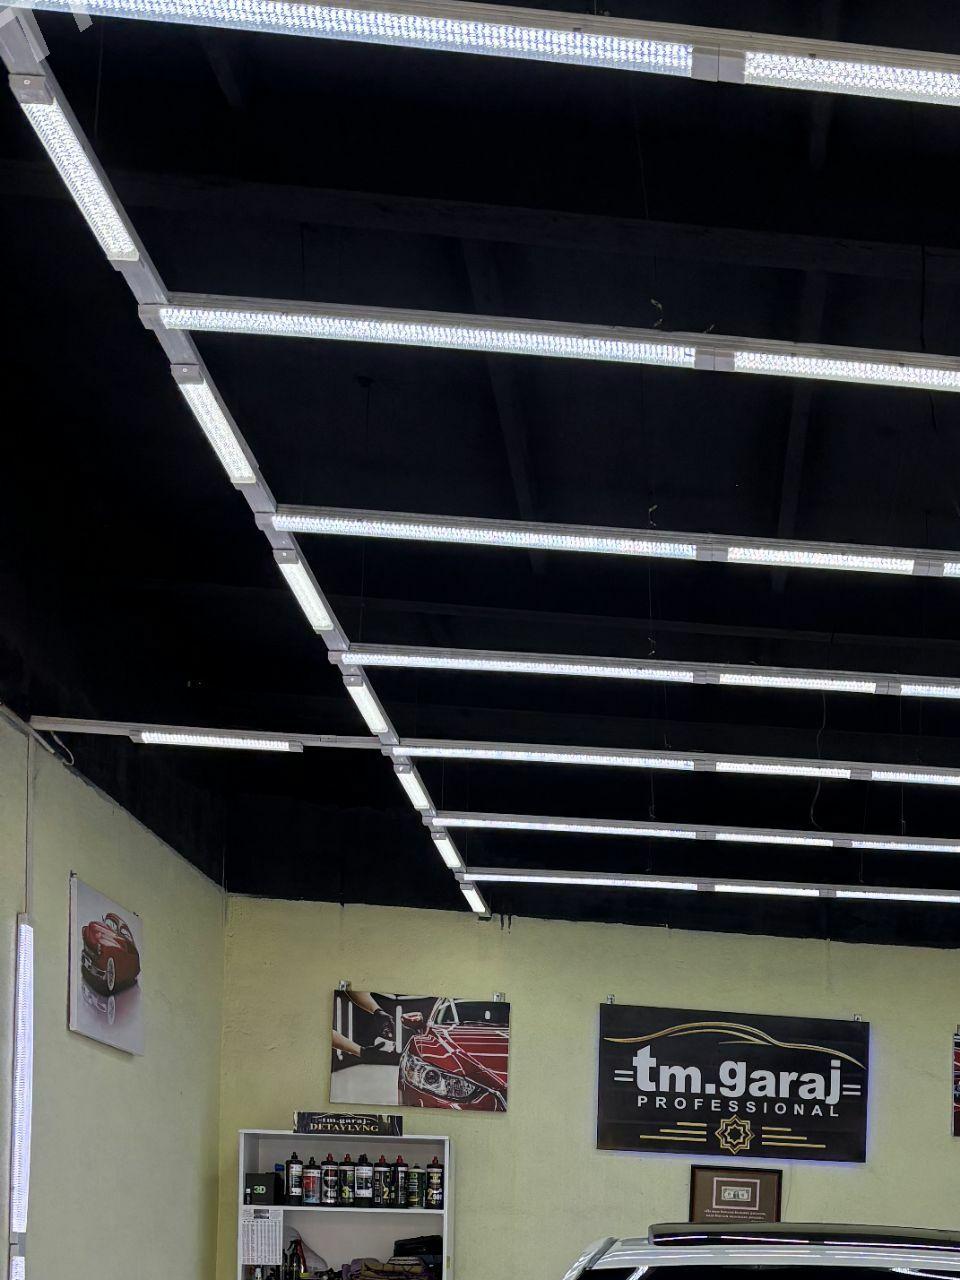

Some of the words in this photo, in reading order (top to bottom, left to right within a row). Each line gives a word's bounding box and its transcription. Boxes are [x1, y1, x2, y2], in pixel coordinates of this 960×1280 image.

[632, 1044, 841, 1105] tm.garaj
[637, 1095, 839, 1117] PROFESSIONAL
[310, 1122, 379, 1132] DETAYLYNG
[253, 1185, 266, 1194] 3D
